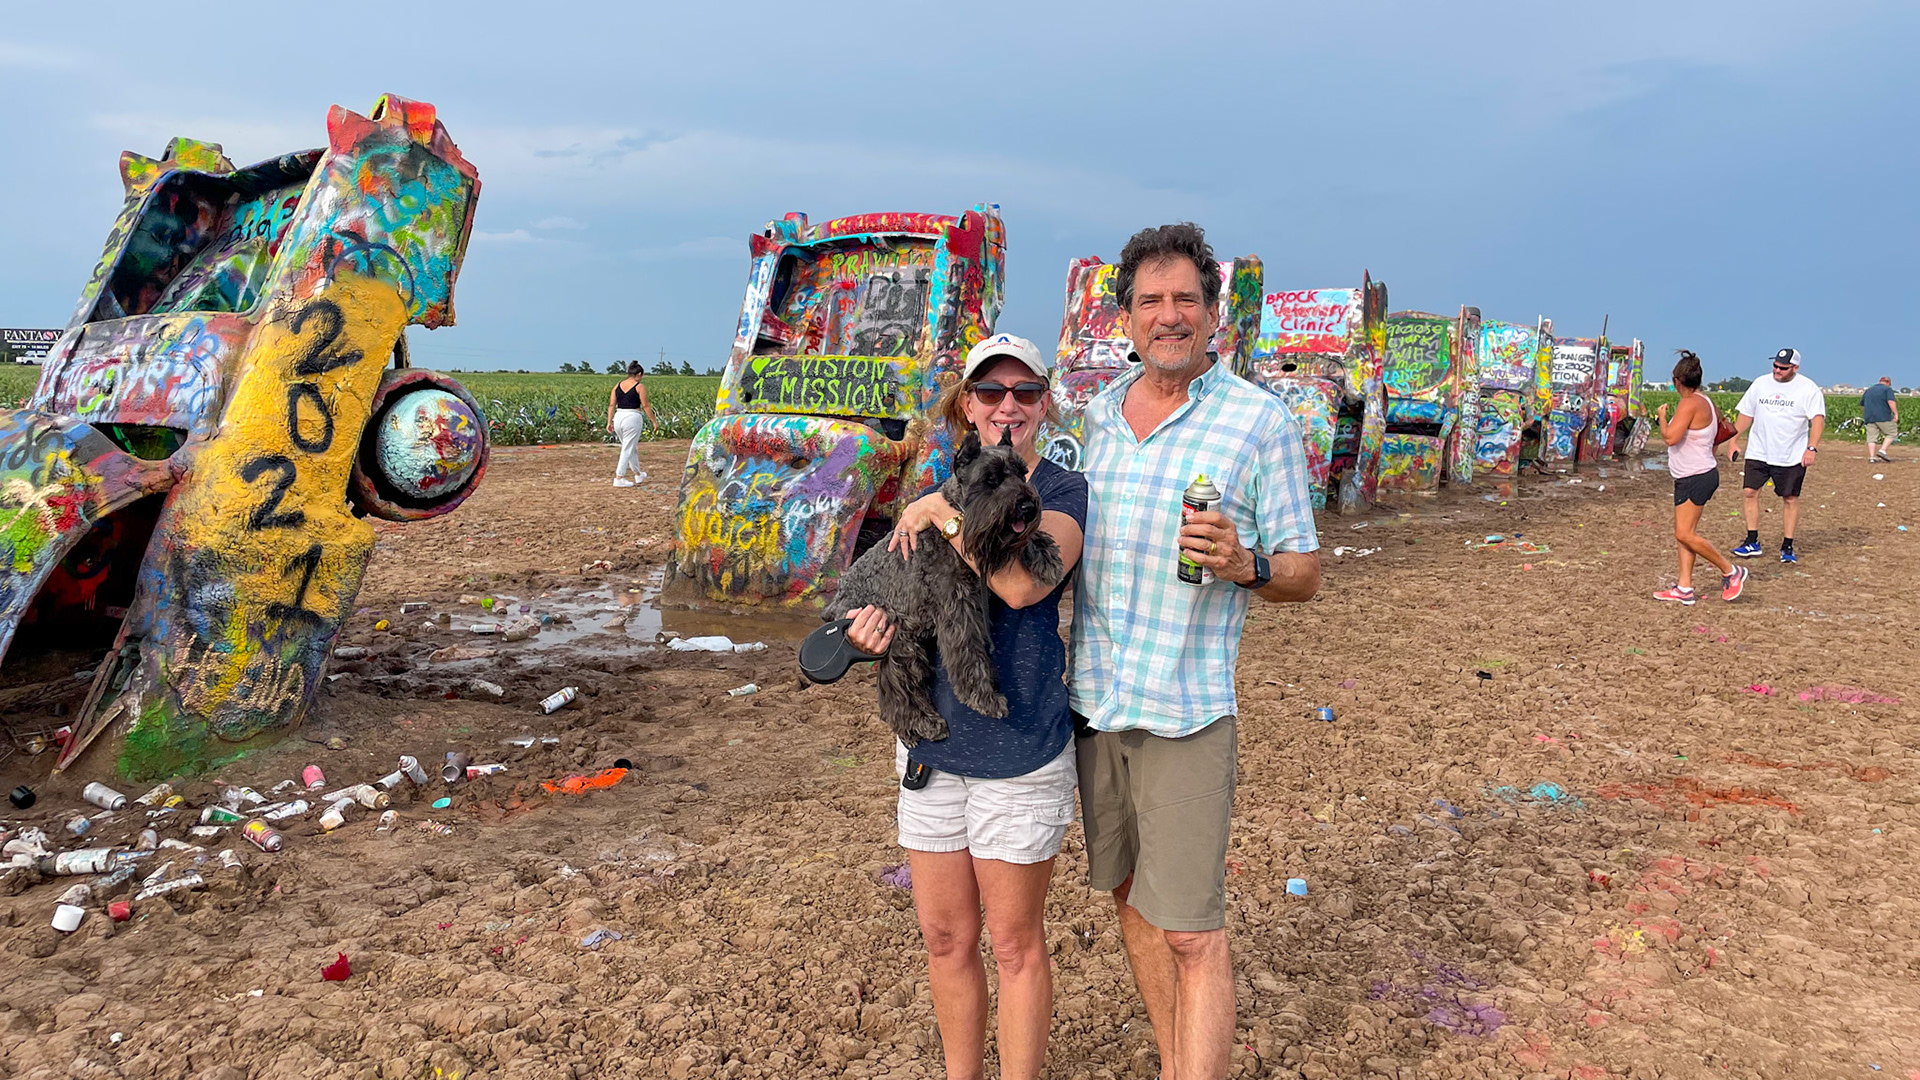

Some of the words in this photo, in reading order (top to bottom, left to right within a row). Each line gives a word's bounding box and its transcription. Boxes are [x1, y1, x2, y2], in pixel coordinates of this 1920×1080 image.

[1266, 291, 1319, 305] BROCK
[1280, 317, 1335, 333] Clinic
[4, 330, 61, 340] FANTASY
[801, 357, 888, 384] VISION
[750, 377, 768, 405] 1
[779, 376, 888, 412] MISSION
[1758, 398, 1795, 407] NAUTIQUE
